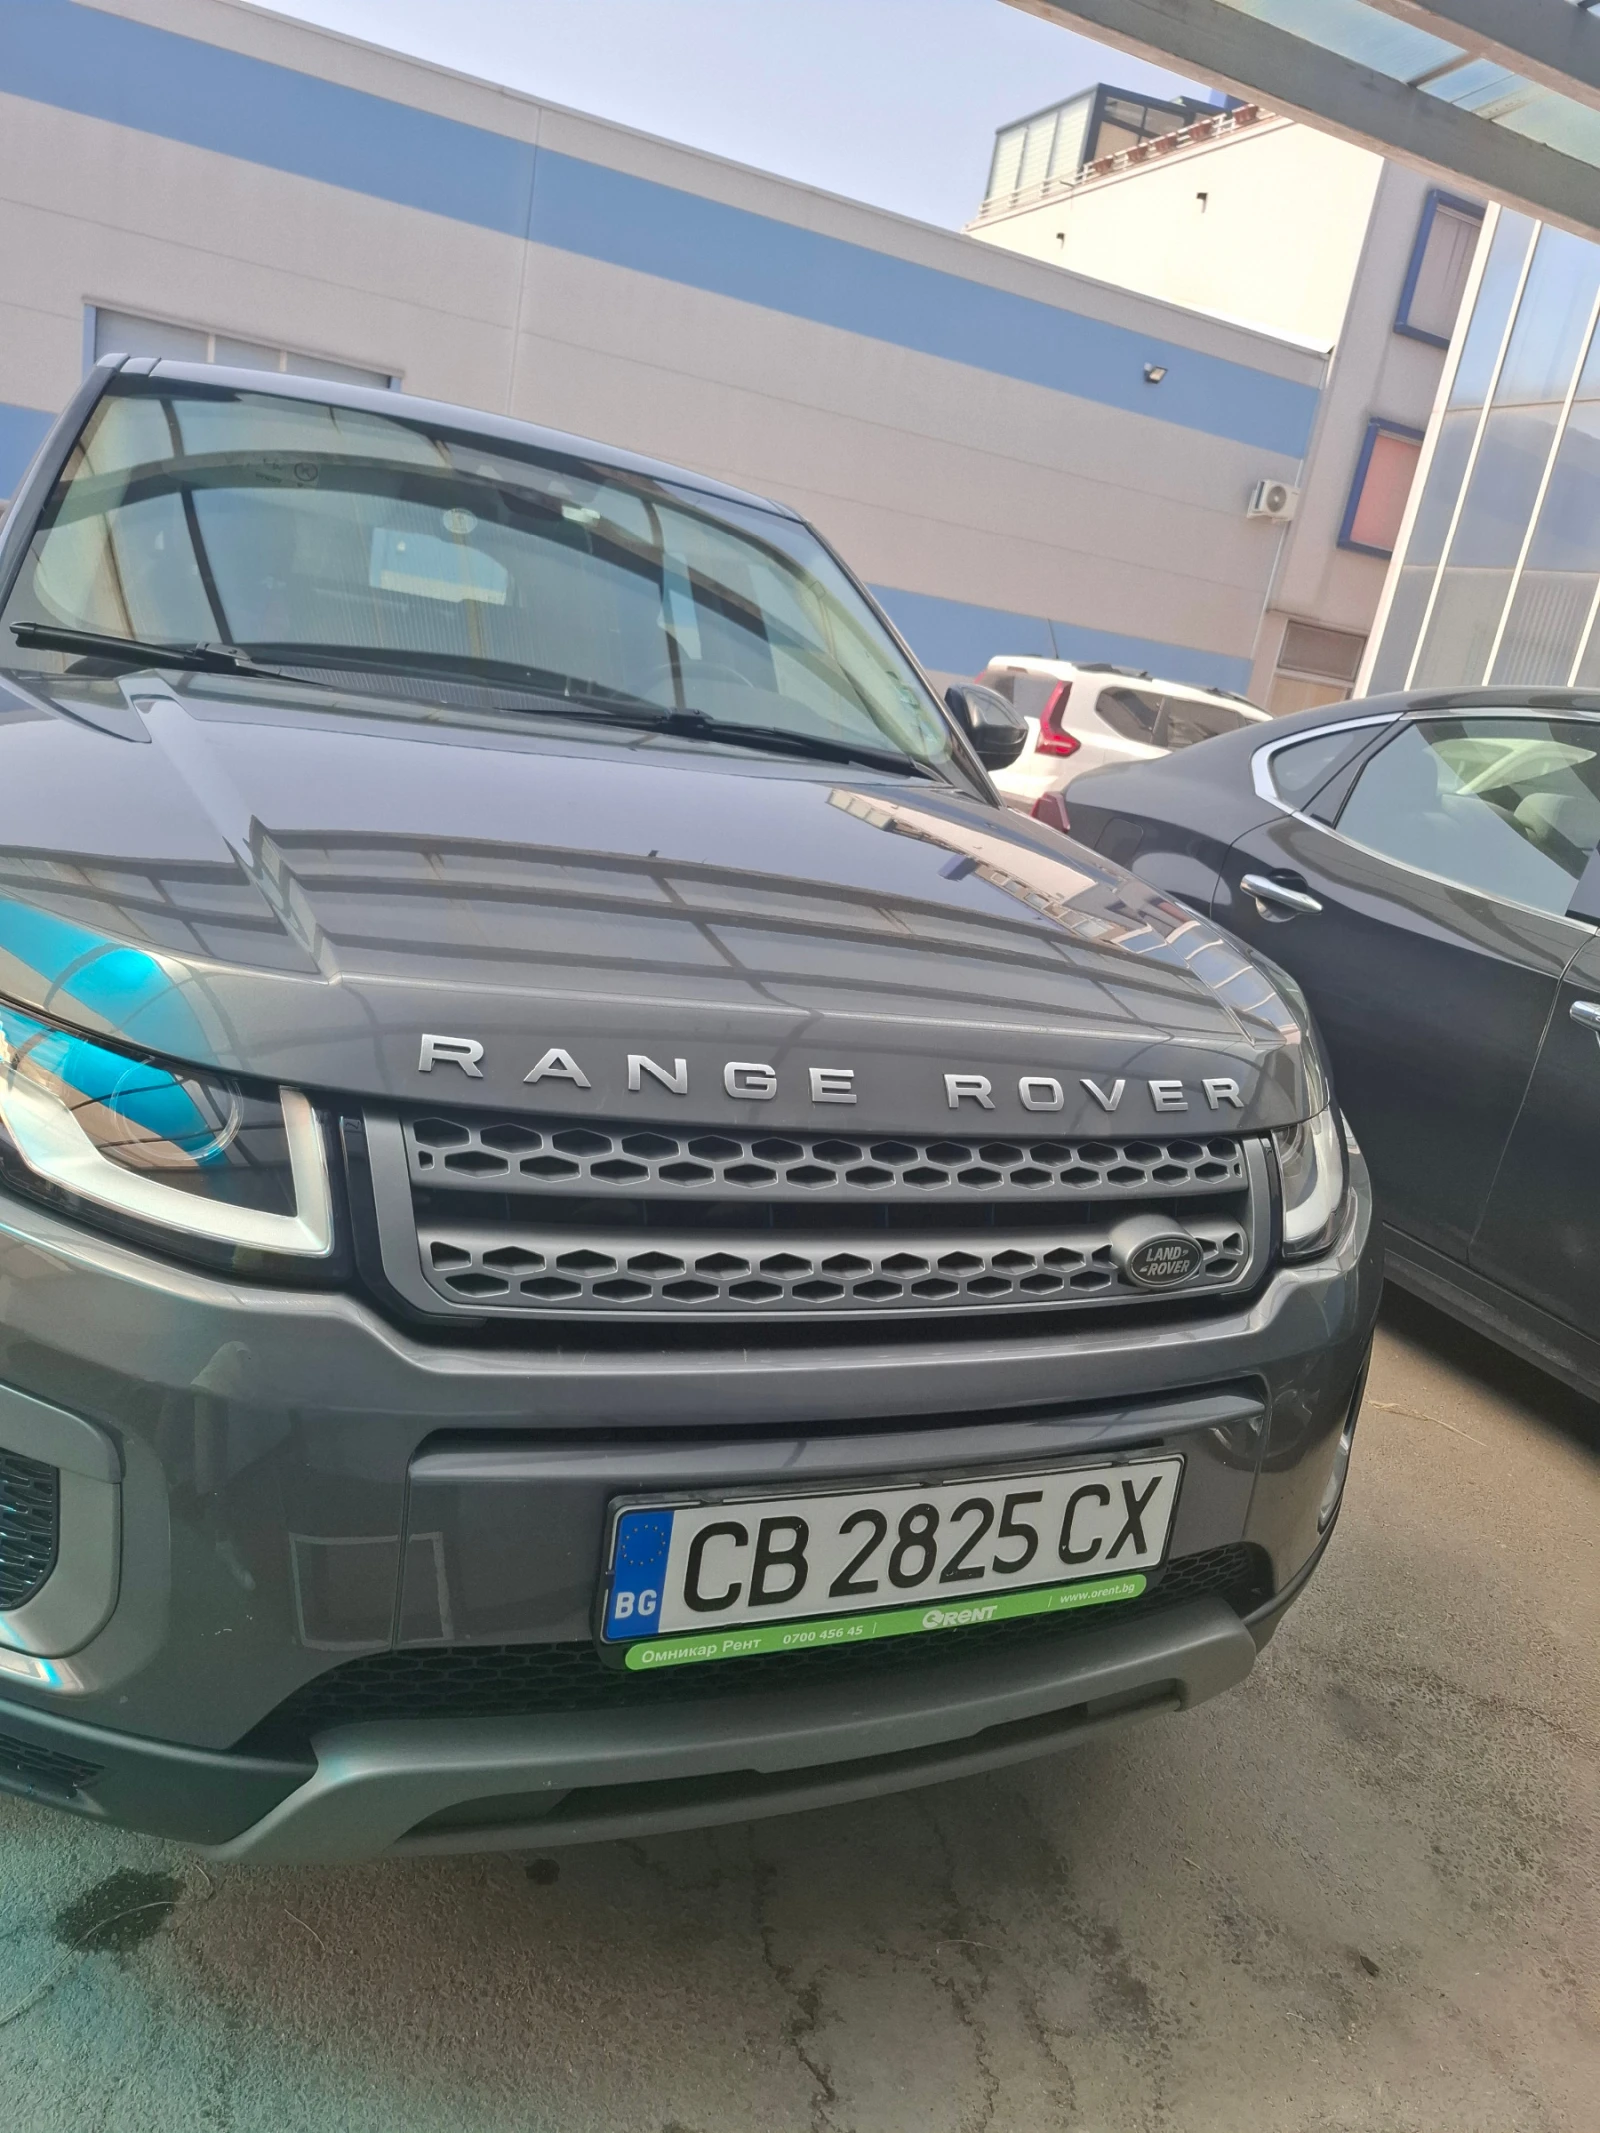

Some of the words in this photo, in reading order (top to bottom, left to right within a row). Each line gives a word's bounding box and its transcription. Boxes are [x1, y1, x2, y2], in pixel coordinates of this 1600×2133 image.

[418, 1033, 858, 1104] RANGE
[943, 1073, 1245, 1112] ROVER
[1146, 1246, 1182, 1261] LAND
[1147, 1260, 1190, 1276] ROVER
[683, 1515, 810, 1613] CB
[828, 1490, 1044, 1598] 2825
[1057, 1475, 1163, 1565] CX
[614, 1589, 658, 1619] BG
[1060, 1582, 1135, 1603] www.orent.bg
[641, 1643, 718, 1664] Омникар
[722, 1637, 761, 1653] Рент
[783, 1632, 816, 1645] 0700
[819, 1627, 844, 1641] 456
[847, 1625, 863, 1637] 45
